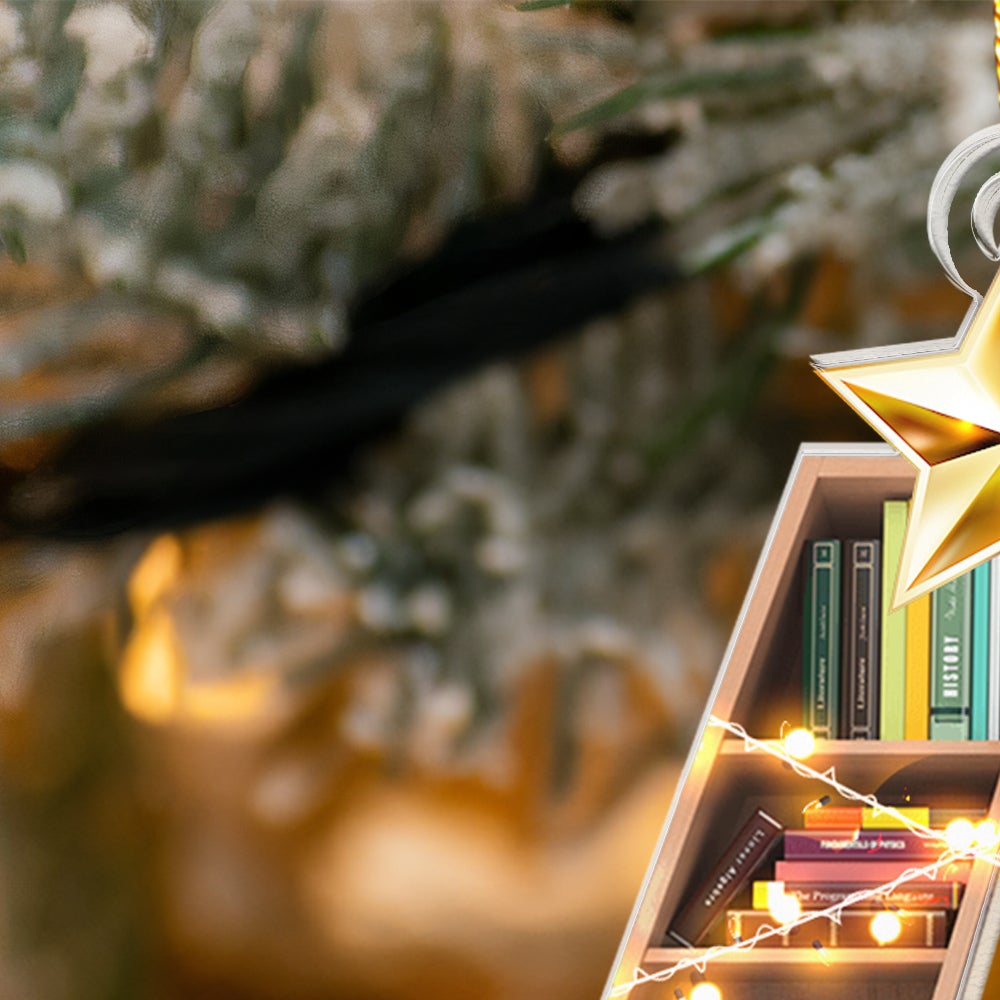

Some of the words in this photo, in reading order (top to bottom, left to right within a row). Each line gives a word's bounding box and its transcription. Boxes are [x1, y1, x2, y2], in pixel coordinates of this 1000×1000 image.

[943, 635, 960, 698] HISTORY
[734, 829, 766, 864] Linear
[701, 866, 738, 907] Algebra
